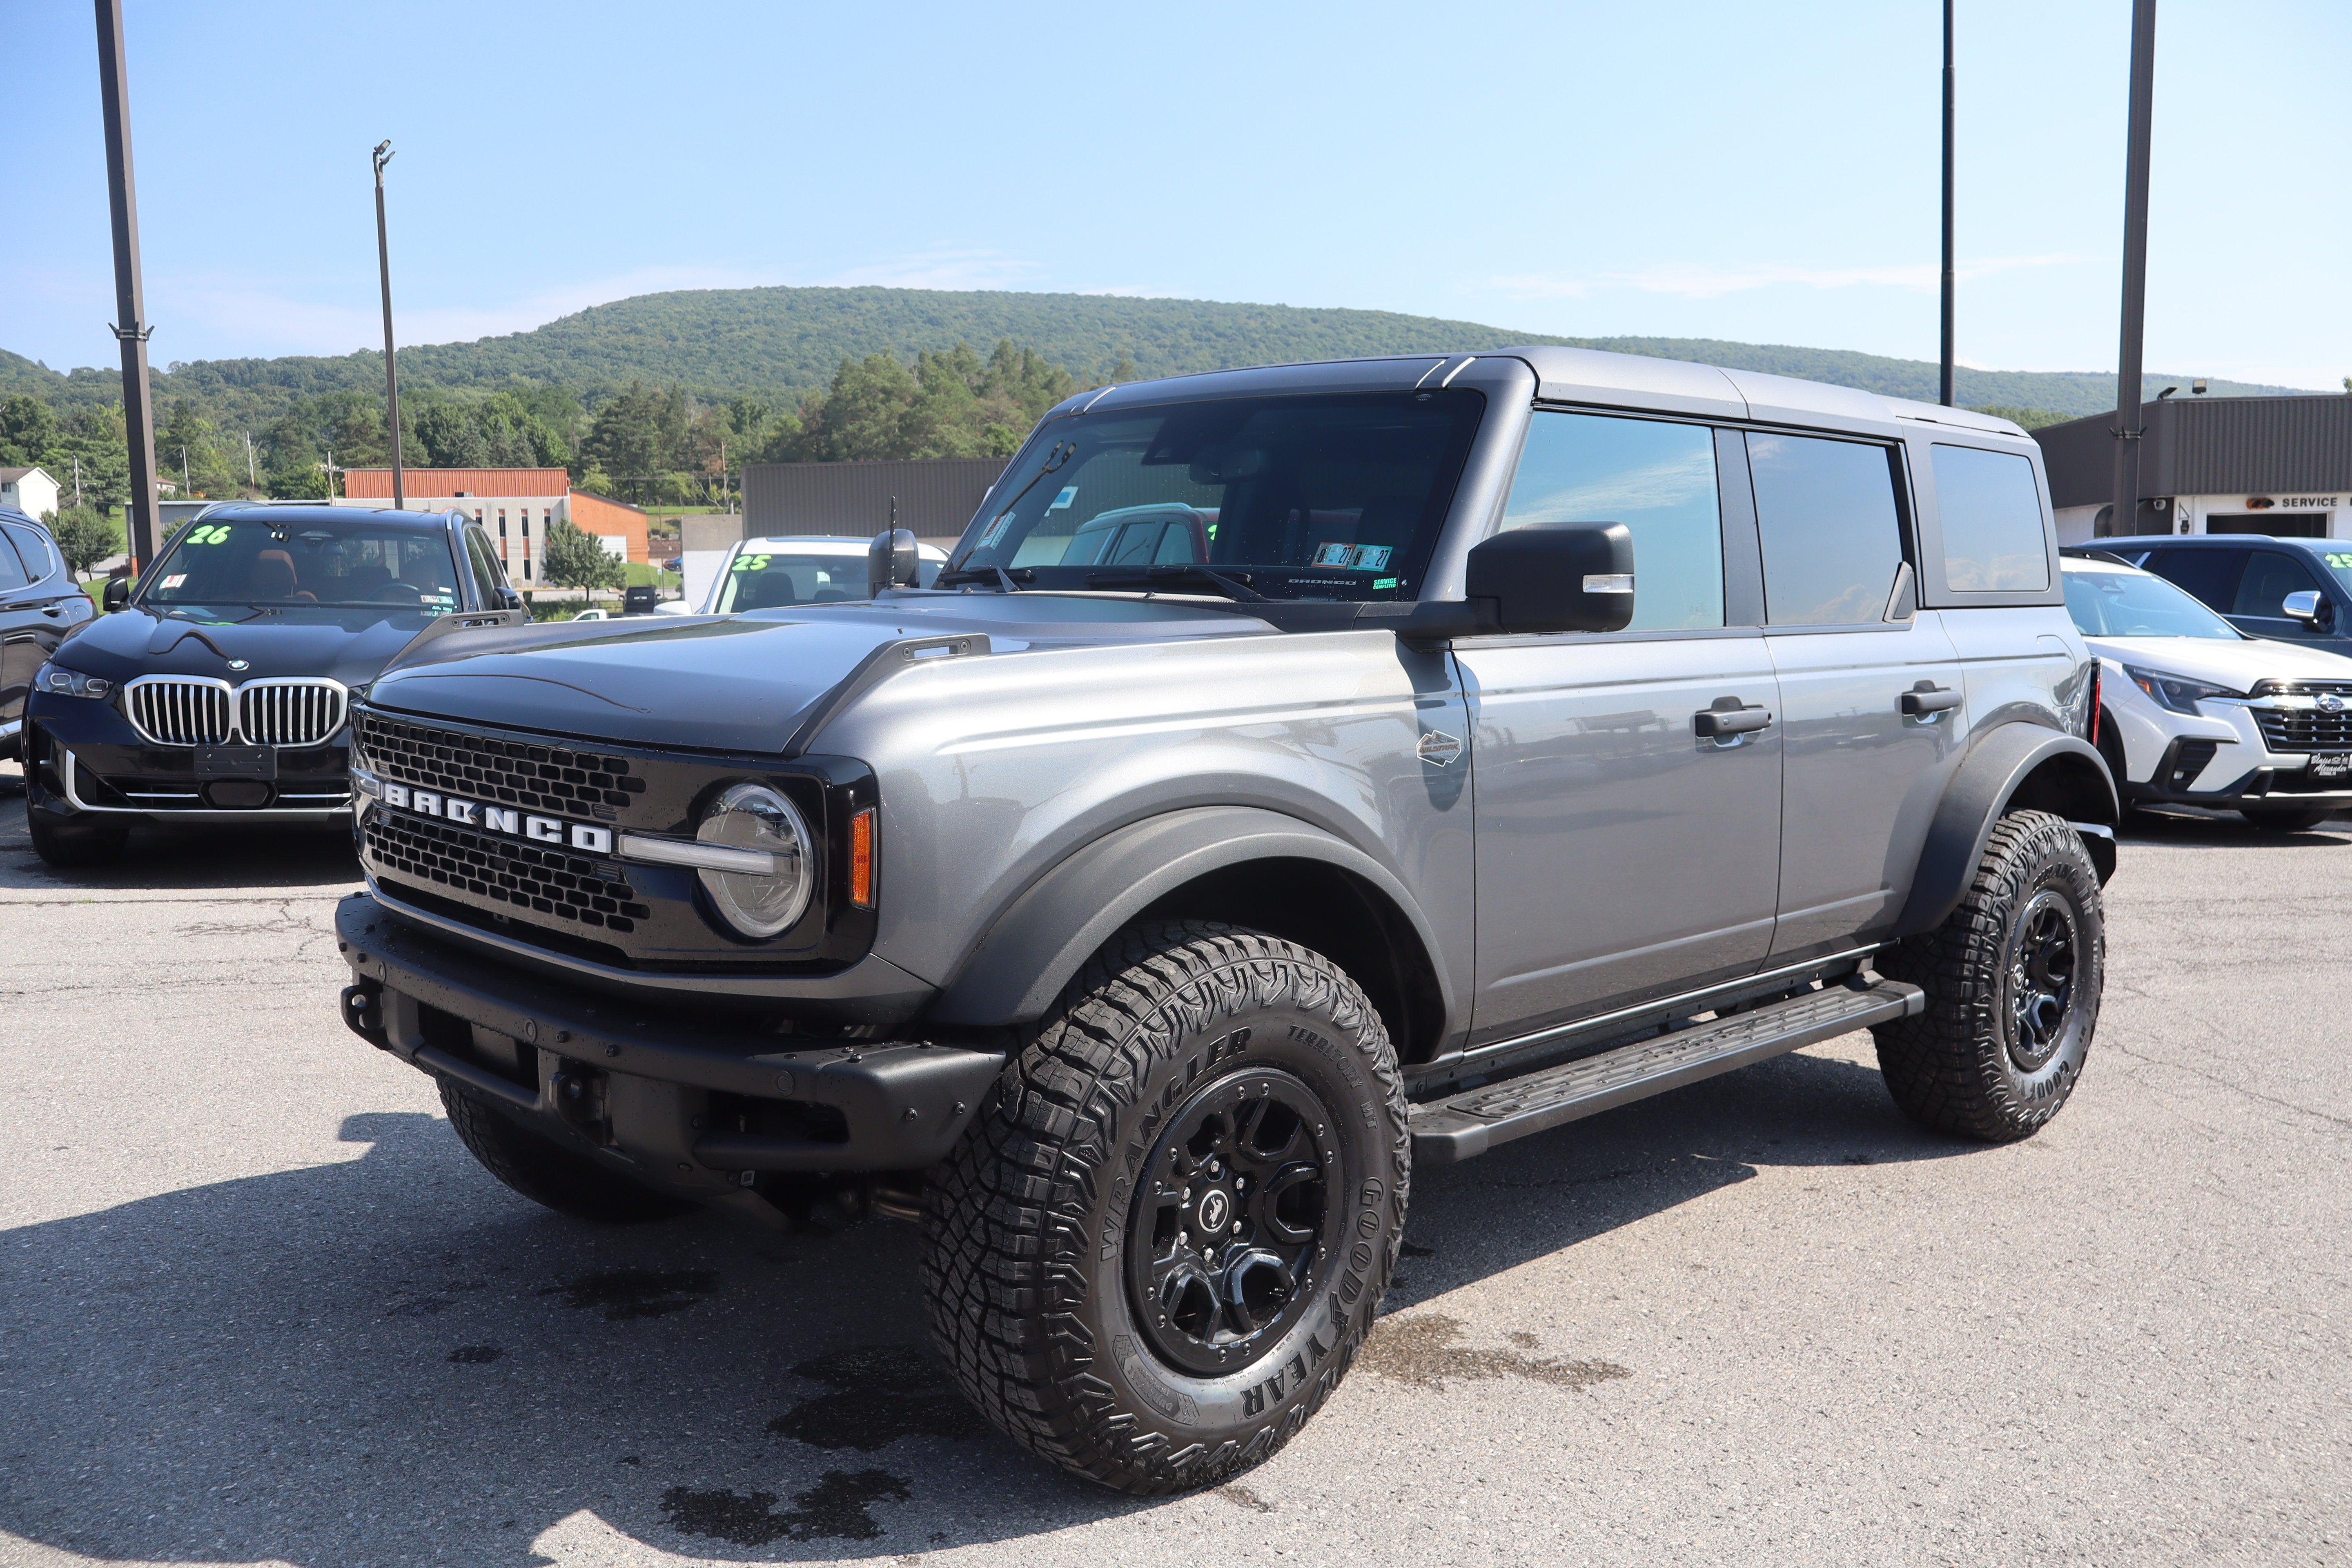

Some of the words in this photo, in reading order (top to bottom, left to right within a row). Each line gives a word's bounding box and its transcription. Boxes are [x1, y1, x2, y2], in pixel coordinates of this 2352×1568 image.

[2282, 497, 2338, 508] SERVICE
[186, 525, 232, 545] 26
[732, 555, 772, 571] 25
[1317, 548, 1326, 563] 8
[1338, 547, 1352, 565] 27
[1353, 551, 1363, 566] 8
[1375, 550, 1389, 568] 27
[1419, 743, 1459, 754] WILDTRAK
[385, 782, 612, 854] BRONCO
[2031, 861, 2094, 916] WRANGLER
[1286, 1024, 1363, 1089] TERRITORY
[1360, 1101, 1379, 1129] MT
[1100, 1026, 1252, 1262] WRANGLER
[1240, 1176, 1384, 1419] GOODYEAR
